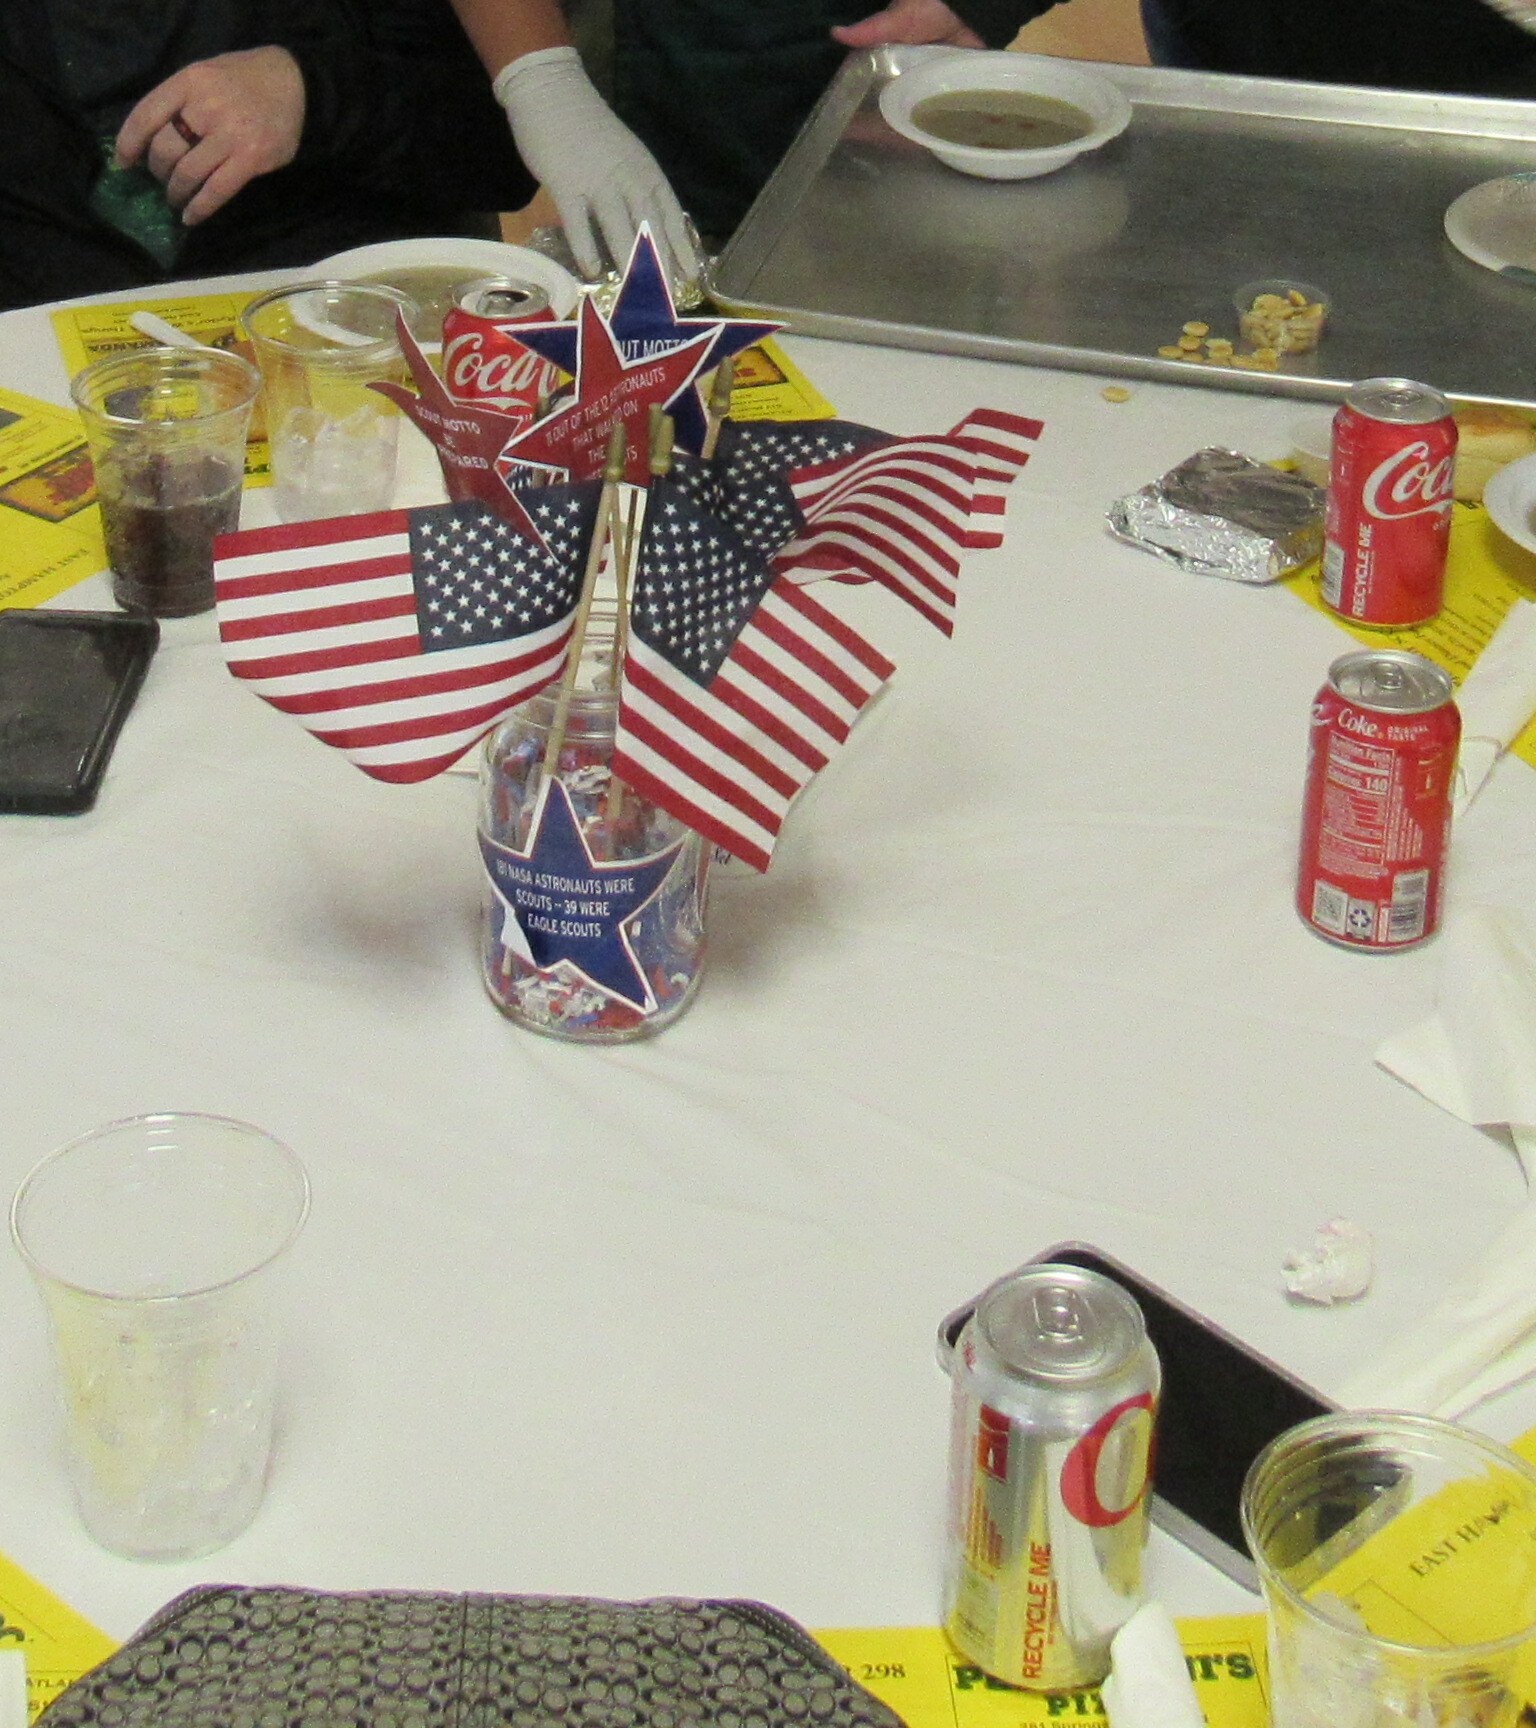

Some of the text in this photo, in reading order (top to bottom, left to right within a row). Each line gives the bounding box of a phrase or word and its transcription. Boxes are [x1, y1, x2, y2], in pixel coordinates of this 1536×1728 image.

[443, 418, 481, 434] MOTTO
[553, 428, 569, 442] OUT
[569, 416, 581, 429] OF
[583, 406, 599, 422] THE
[600, 399, 609, 413] 12
[572, 433, 593, 450] THAT
[623, 401, 638, 415] ON
[1352, 523, 1372, 616] RECYCLE ME
[1337, 708, 1378, 738] Coke
[1365, 777, 1388, 792] 140
[508, 864, 532, 884] NASA
[535, 873, 602, 894] ASTRONAUTS
[604, 878, 635, 894] WERE
[516, 888, 553, 910] SCOUTS
[564, 900, 577, 915] 39
[579, 900, 610, 916] WERE
[528, 913, 601, 937] EAGLE SCOUTS
[1408, 1539, 1457, 1576] EAST
[1022, 1541, 1052, 1678] RECYCLE ME
[863, 1661, 907, 1683] 298
